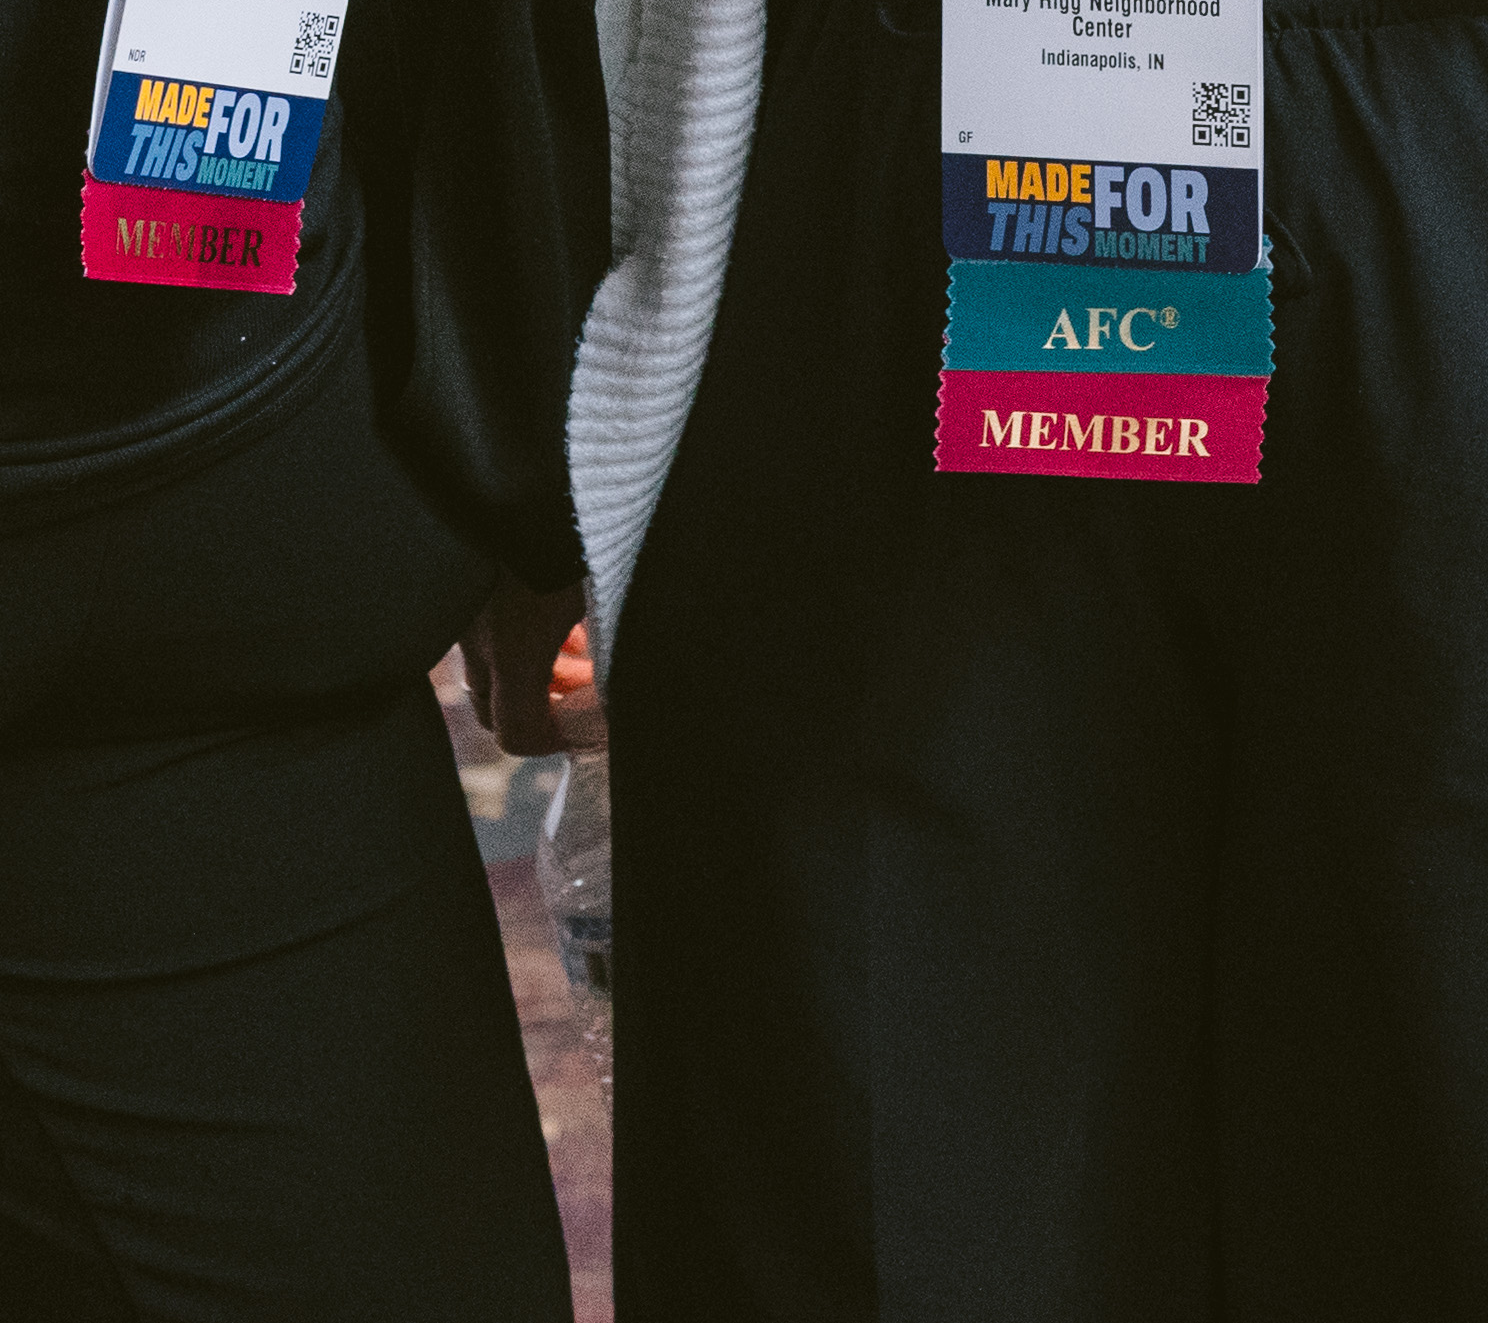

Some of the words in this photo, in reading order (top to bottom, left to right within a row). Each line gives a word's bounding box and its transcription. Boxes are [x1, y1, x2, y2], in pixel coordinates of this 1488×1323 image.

[1072, 16, 1133, 39] Center
[1041, 48, 1141, 72] Indianapolis,
[1148, 53, 1165, 70] IN
[134, 79, 215, 129] MADE
[203, 89, 291, 163] FOR
[958, 130, 974, 144] GF
[124, 123, 205, 182] THIS
[196, 156, 280, 192] MOMENT
[986, 159, 1092, 204] MADE
[1094, 165, 1211, 234] FOR
[115, 217, 263, 267] MEMBER
[986, 202, 1092, 256] THIS
[1094, 231, 1211, 264] MOMENT
[978, 409, 1212, 457] MEMBER
